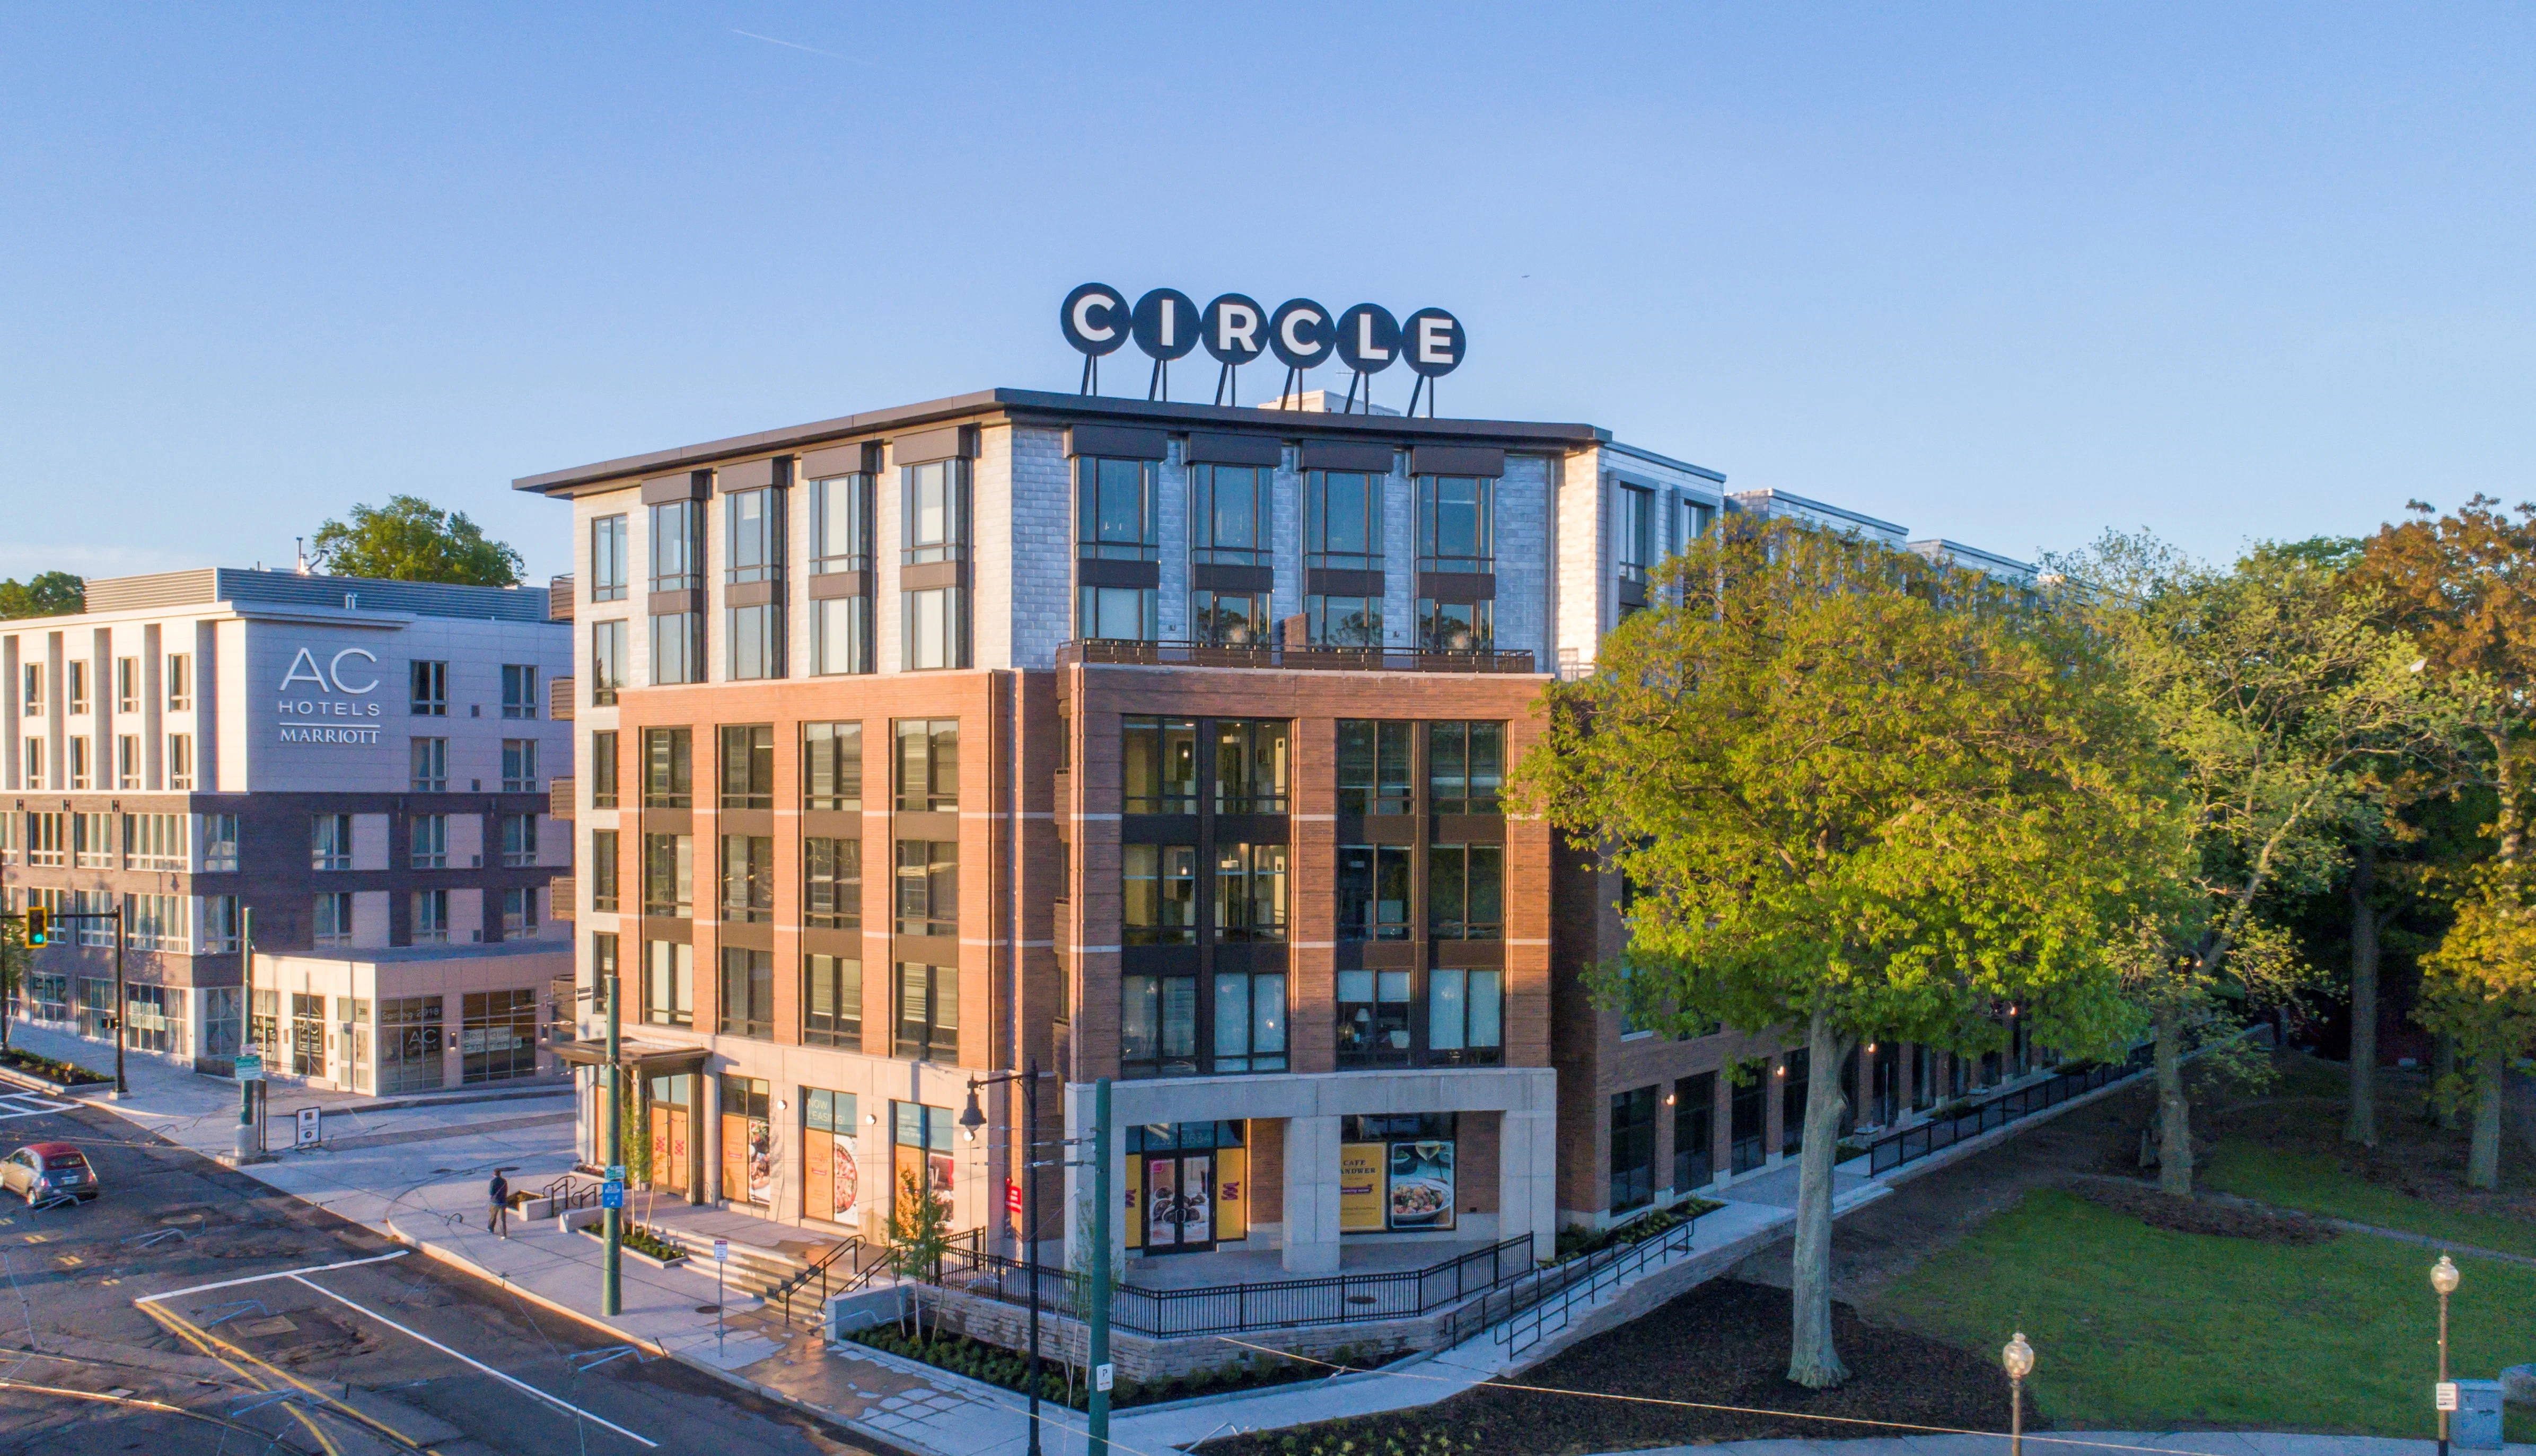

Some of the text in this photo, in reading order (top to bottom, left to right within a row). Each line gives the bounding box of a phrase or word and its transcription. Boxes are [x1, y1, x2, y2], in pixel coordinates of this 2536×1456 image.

[1073, 293, 1453, 364] CIRCLE
[279, 647, 380, 694] AC
[278, 700, 380, 717] HOTELS
[279, 728, 380, 744] MARRIOTT
[408, 1029, 437, 1045] AC
[808, 1098, 828, 1109] NOW
